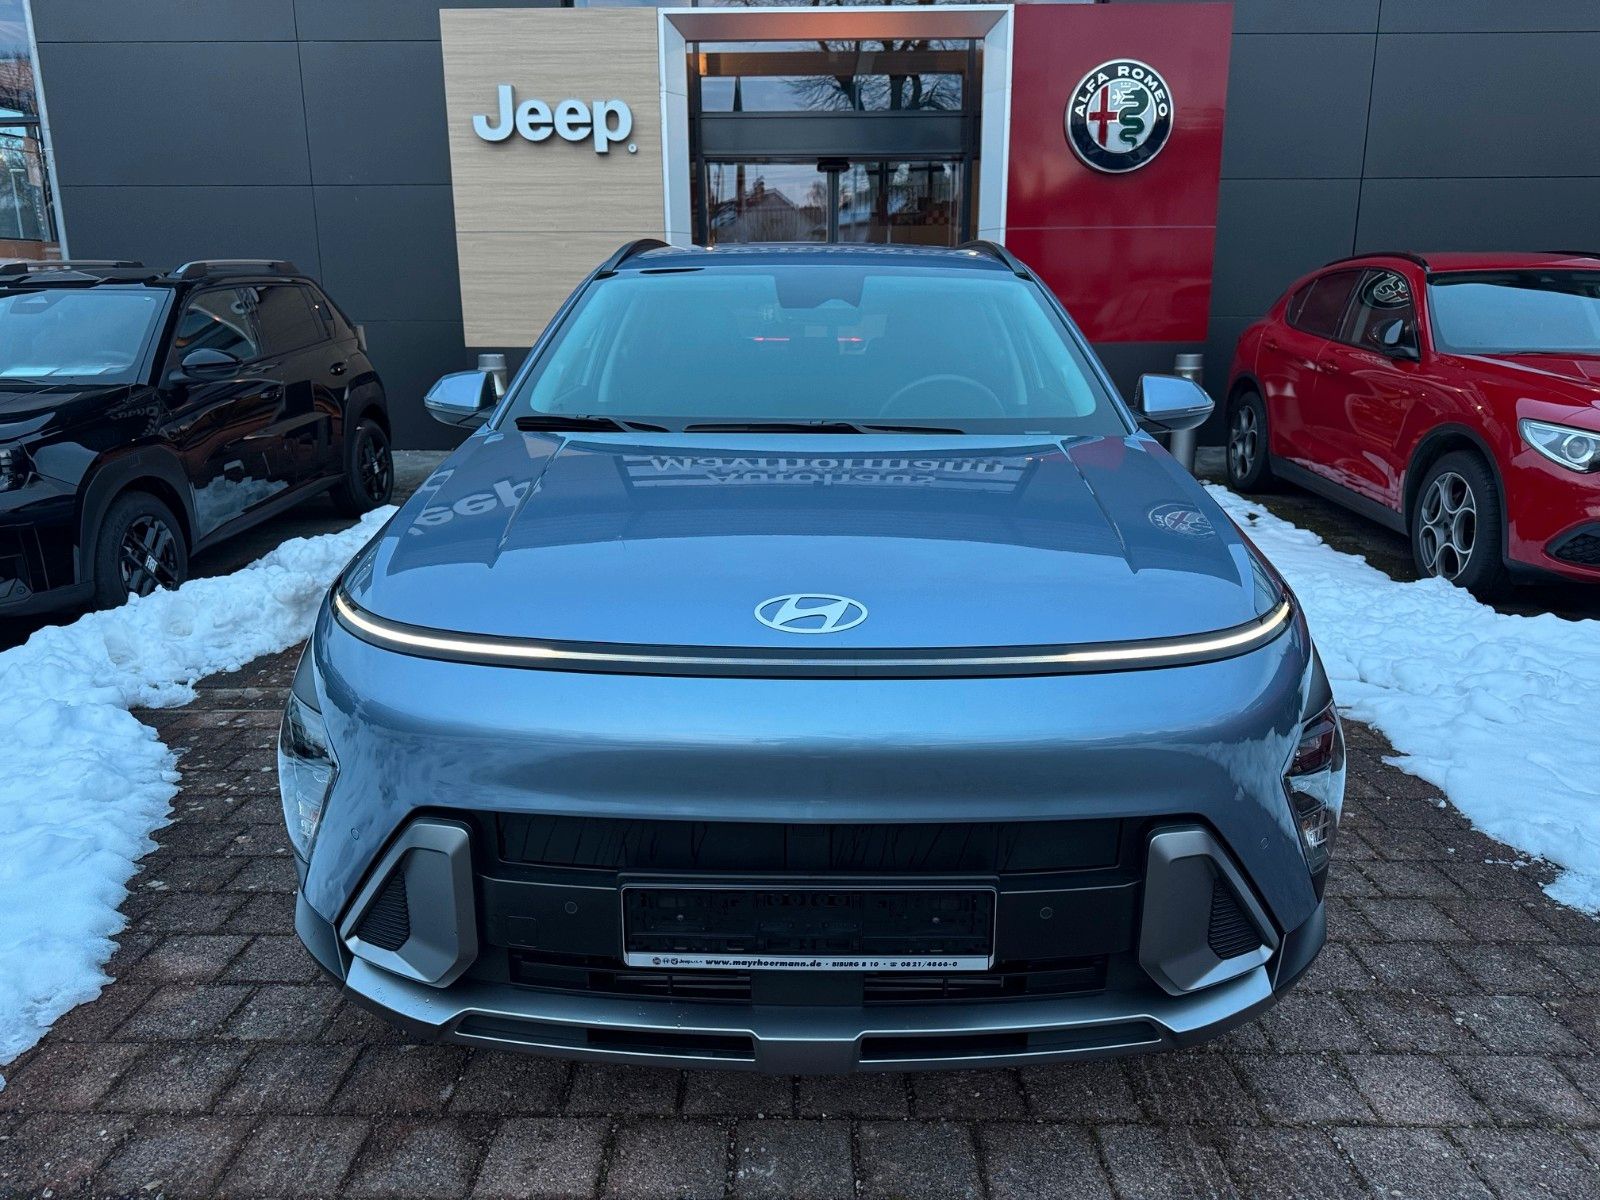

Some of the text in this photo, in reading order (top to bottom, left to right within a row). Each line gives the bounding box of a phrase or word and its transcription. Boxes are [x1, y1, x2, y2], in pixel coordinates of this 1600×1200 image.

[1074, 65, 1168, 118] ALFA ROMEO
[472, 84, 633, 153] Jeep
[704, 958, 822, 968] www.mayrhoermann.de
